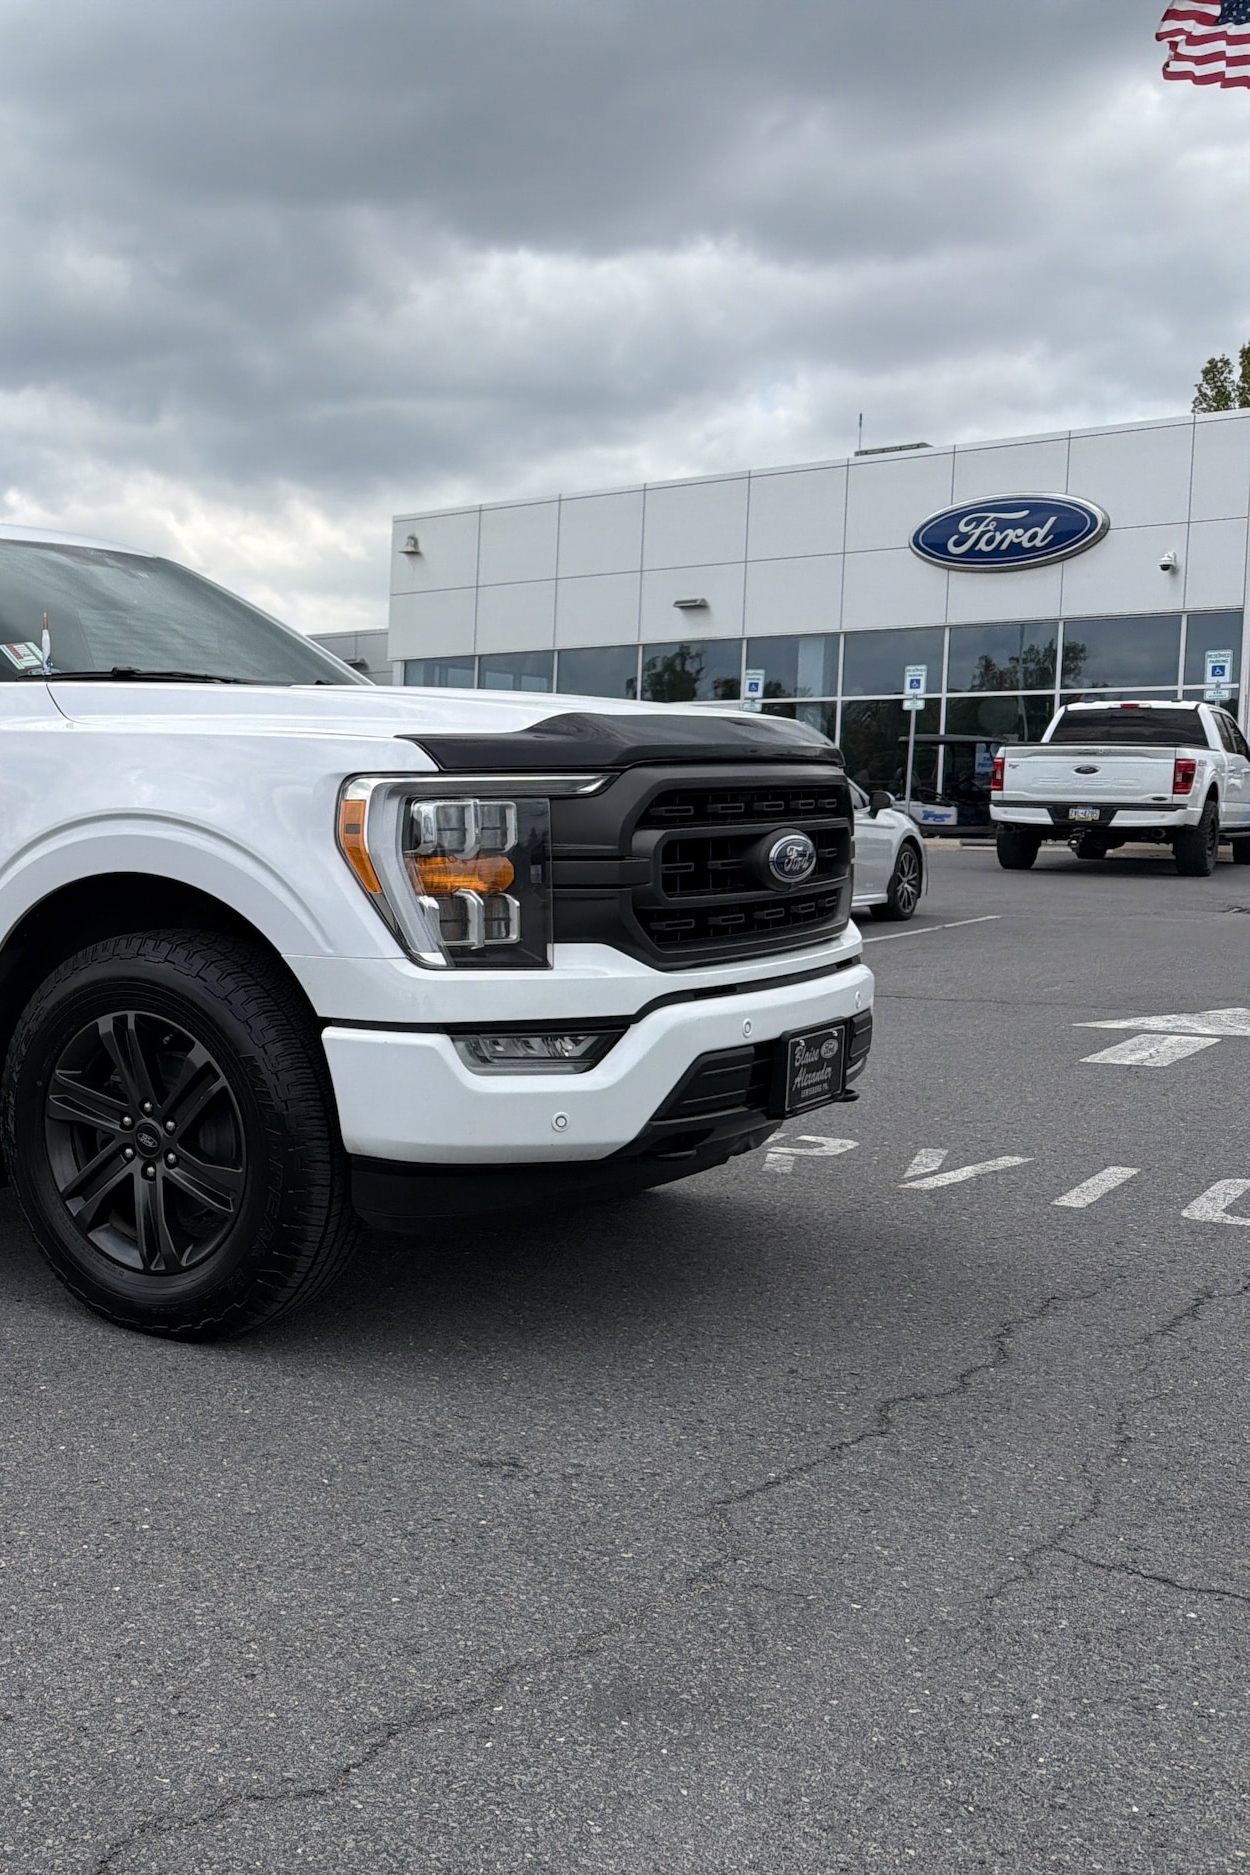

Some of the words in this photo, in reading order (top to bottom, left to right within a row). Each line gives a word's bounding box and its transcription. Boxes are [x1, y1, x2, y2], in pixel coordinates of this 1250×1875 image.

[946, 510, 1058, 555] Ford
[783, 845, 810, 872] Ford
[794, 1045, 820, 1067] Blaise
[792, 1062, 832, 1092] Alexander
